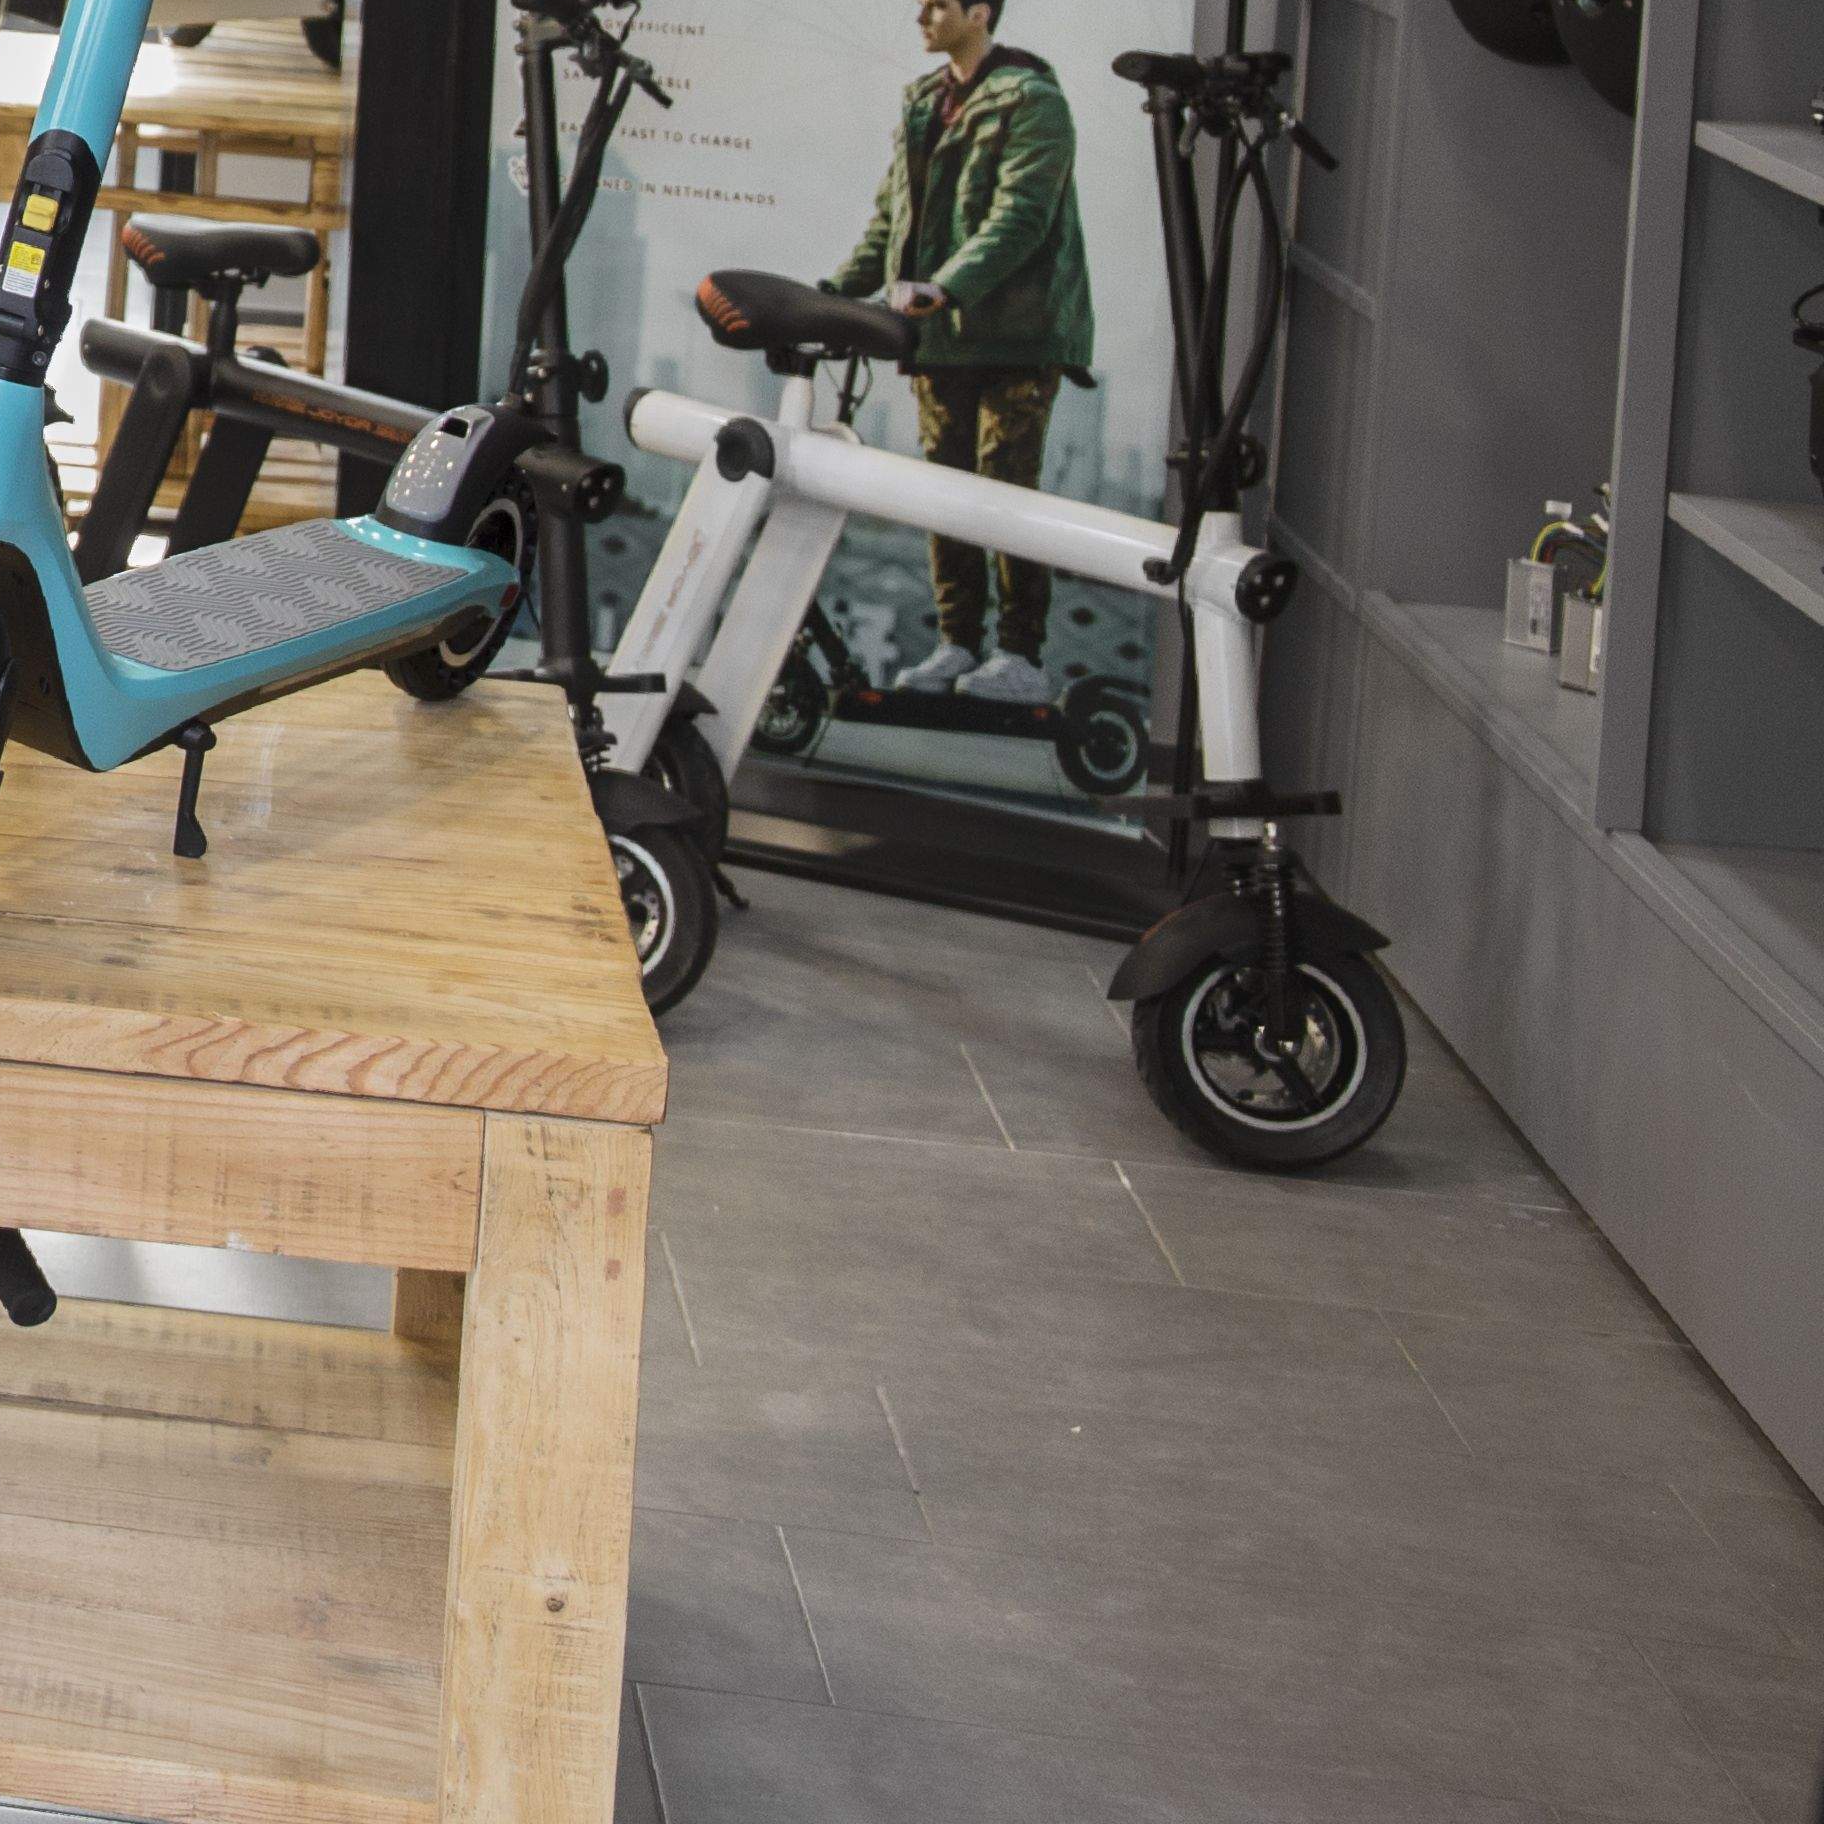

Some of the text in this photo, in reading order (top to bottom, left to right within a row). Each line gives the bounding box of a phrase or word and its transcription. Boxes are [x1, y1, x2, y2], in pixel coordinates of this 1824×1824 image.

[620, 127, 656, 140] FAST
[662, 130, 684, 142] TO
[689, 133, 752, 149] CHARGE
[663, 183, 777, 206] NETHERLANDS
